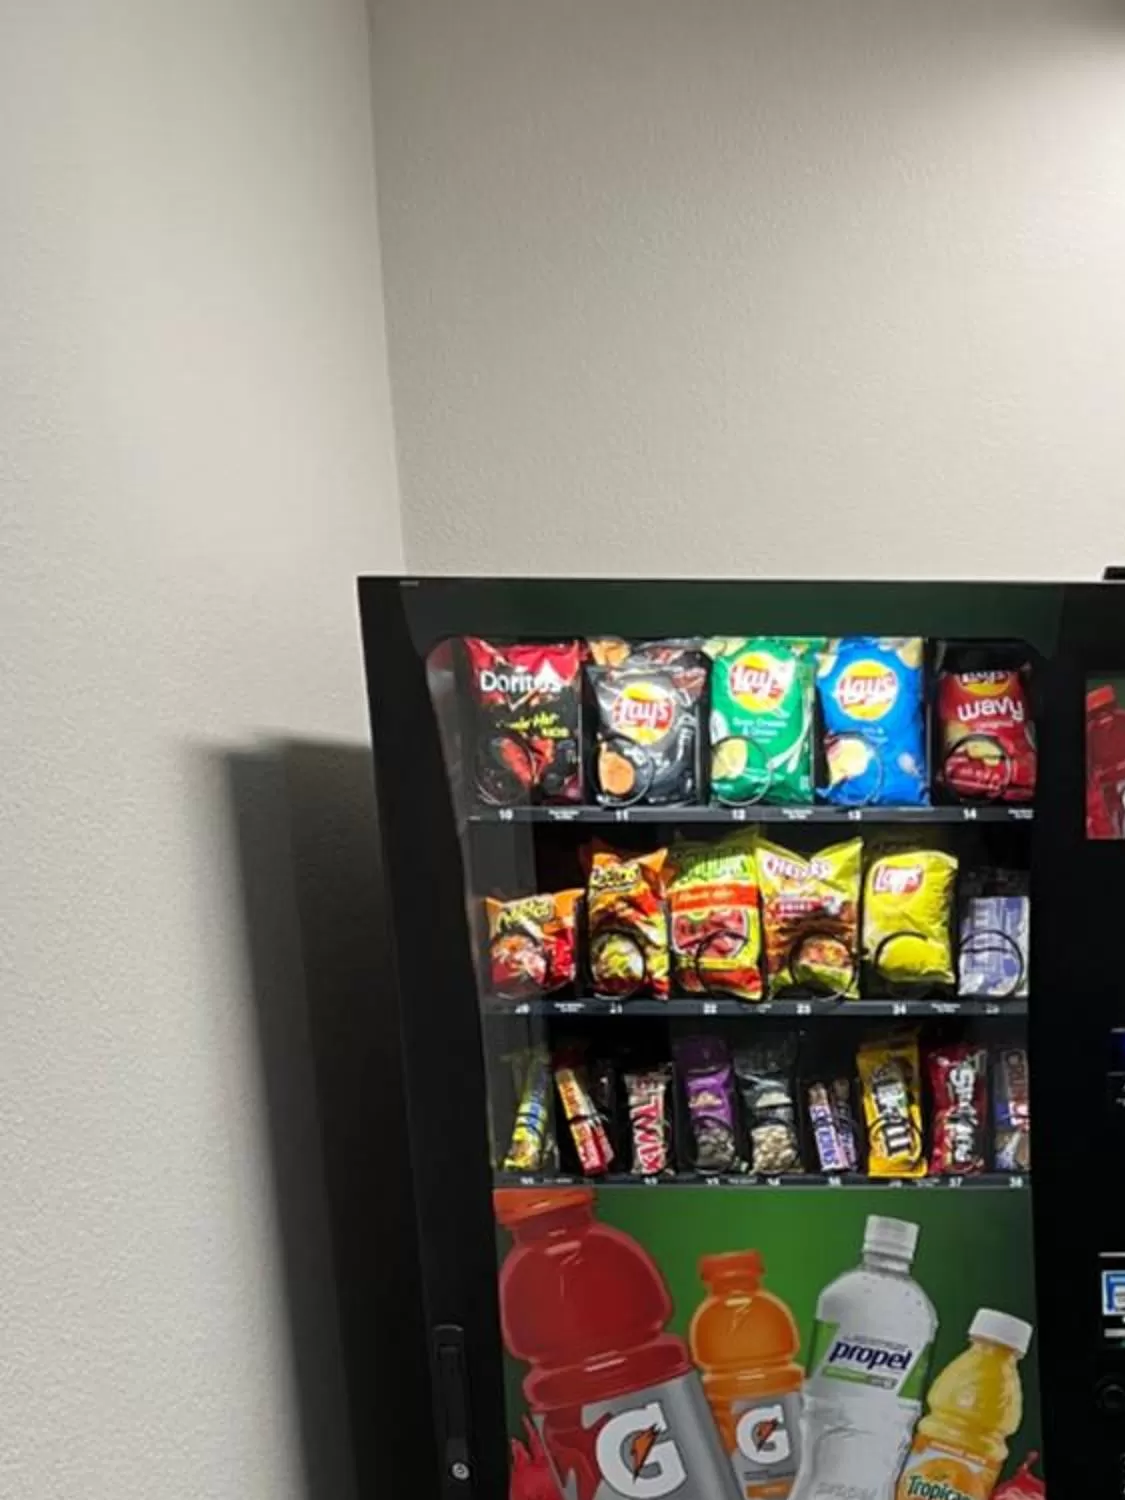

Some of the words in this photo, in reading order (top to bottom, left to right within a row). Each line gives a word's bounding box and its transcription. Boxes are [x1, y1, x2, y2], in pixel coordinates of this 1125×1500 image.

[480, 667, 563, 693] Doritos
[828, 1340, 913, 1371] propel
[596, 1402, 687, 1499] G
[736, 1404, 791, 1464] G
